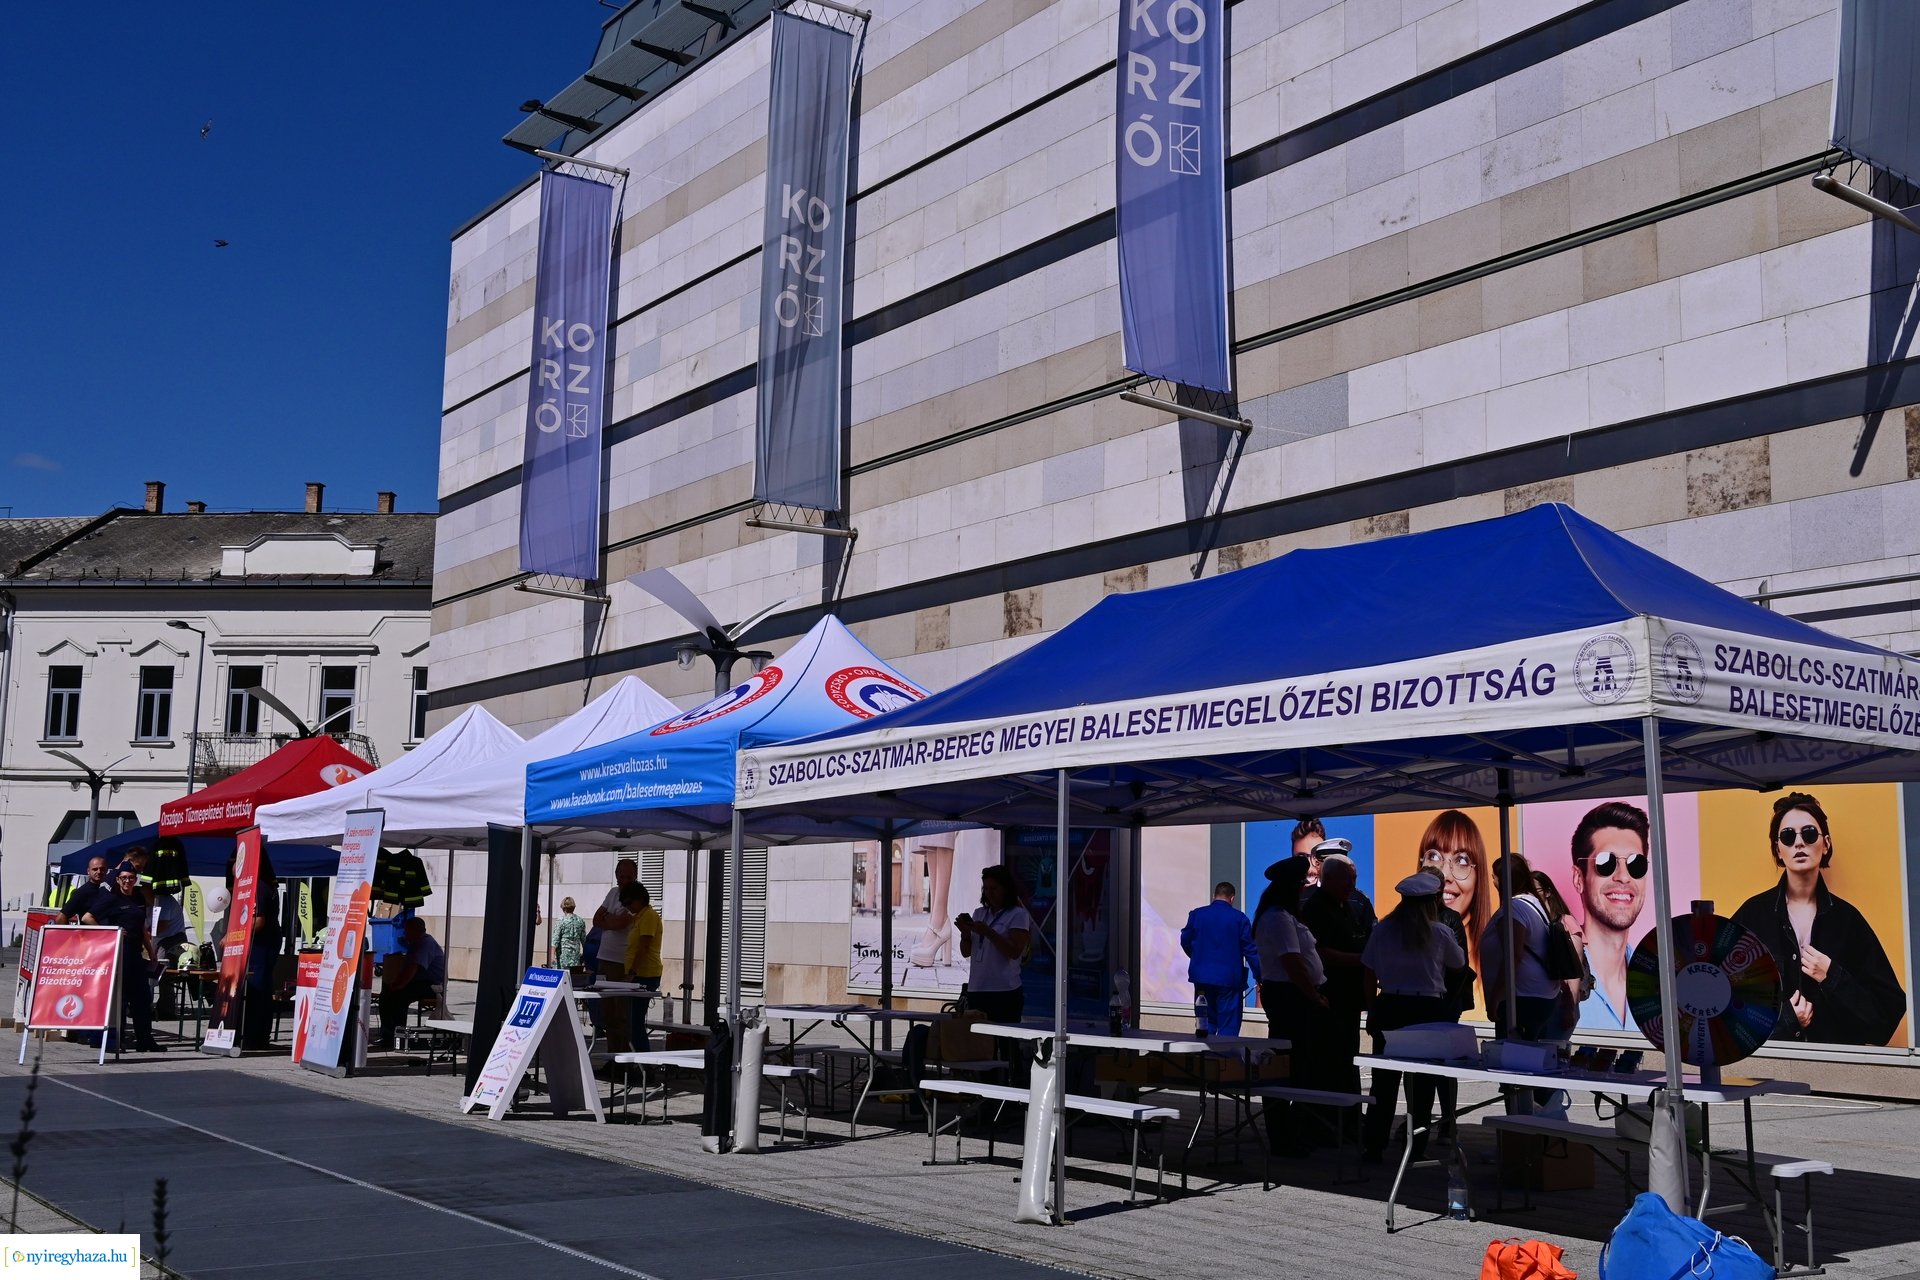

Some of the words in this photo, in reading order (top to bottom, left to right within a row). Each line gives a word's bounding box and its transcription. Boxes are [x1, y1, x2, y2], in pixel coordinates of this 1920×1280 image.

[853, 669, 886, 679] ORFK
[1714, 644, 1920, 701] SZABOLCS-SZATMÁR
[830, 674, 854, 710] ORSZÁGOS
[768, 730, 995, 786] SZABOLCS-SZATMÁR-BEREG
[999, 717, 1076, 753] MEGYEI
[1081, 681, 1363, 742] BALESETMEGELŐZÉSI
[1371, 658, 1556, 713] BIZOTTSÁG
[579, 755, 668, 781] www.kreszvaltozas.hu
[550, 779, 703, 810] www.facebook.com/balesetmegelozes
[160, 810, 184, 829] Országos
[226, 798, 253, 820] Bizottság
[853, 941, 904, 959] Tamis
[42, 955, 84, 965] Országos
[41, 966, 109, 977] Tűzmegelőzési
[1687, 966, 1721, 978] KRESZ
[39, 976, 83, 987] Bizottság
[520, 1001, 540, 1016] ITT
[1684, 1002, 1719, 1016] KERÉK
